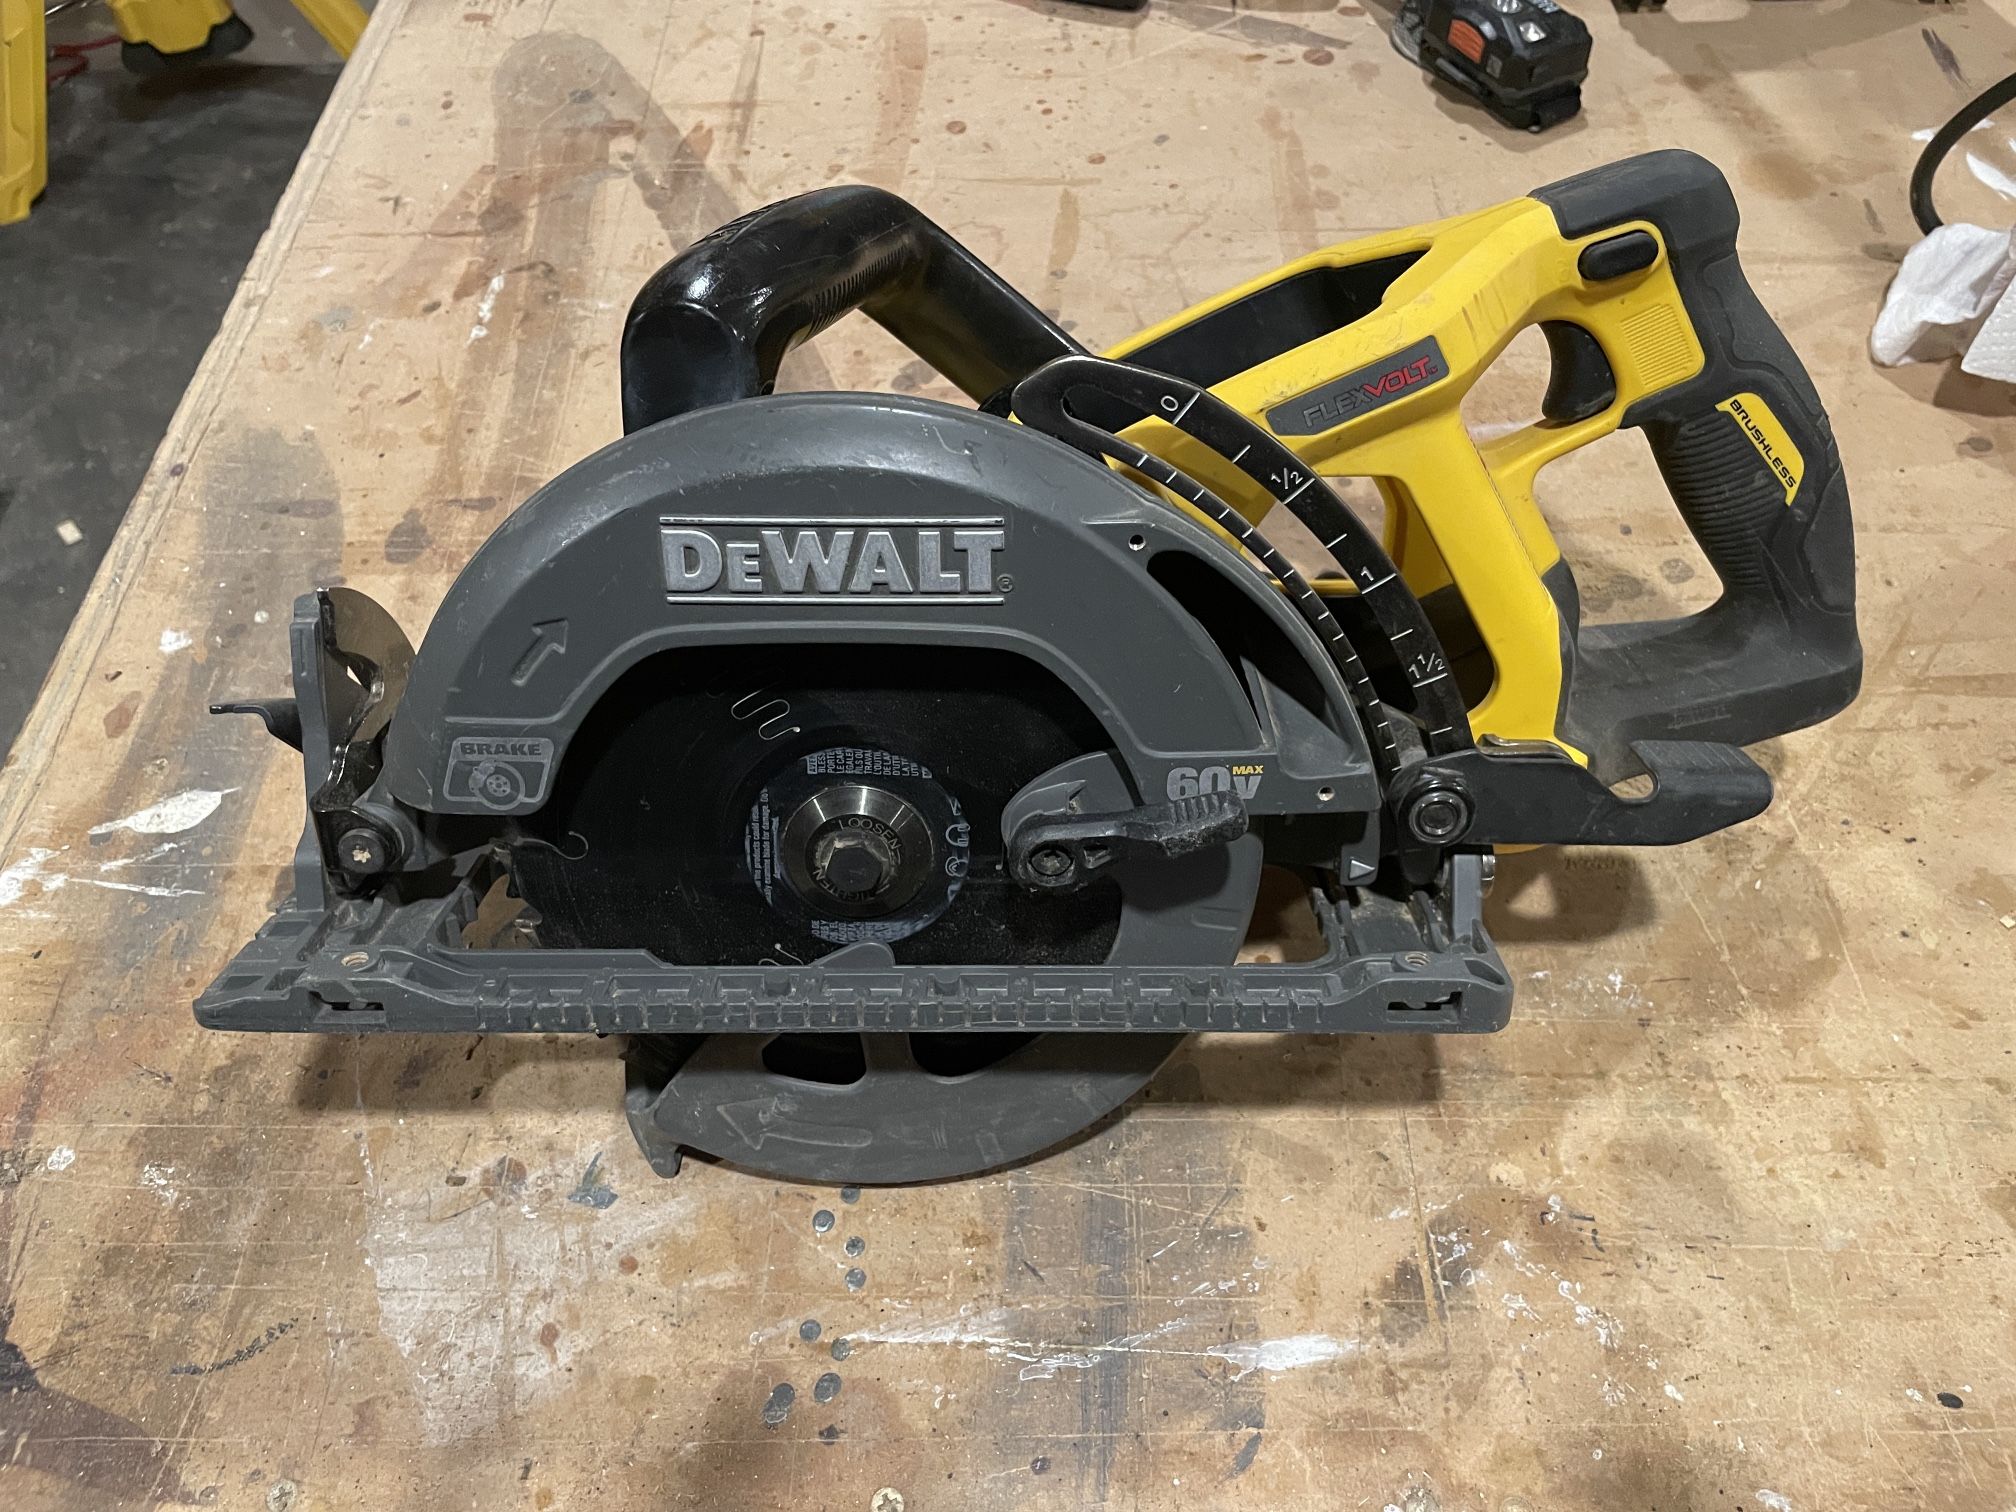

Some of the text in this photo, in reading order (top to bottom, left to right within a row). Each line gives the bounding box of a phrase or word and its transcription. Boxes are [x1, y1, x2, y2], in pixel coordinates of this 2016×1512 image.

[1303, 355, 1431, 428] FLEXVOLT
[1160, 394, 1179, 412] 0
[1729, 399, 1797, 488] BRUSHLESS
[660, 530, 1006, 594] DEWALT
[1360, 565, 1375, 583] 1
[460, 742, 542, 756] BRAKE
[1232, 764, 1264, 775] MAX
